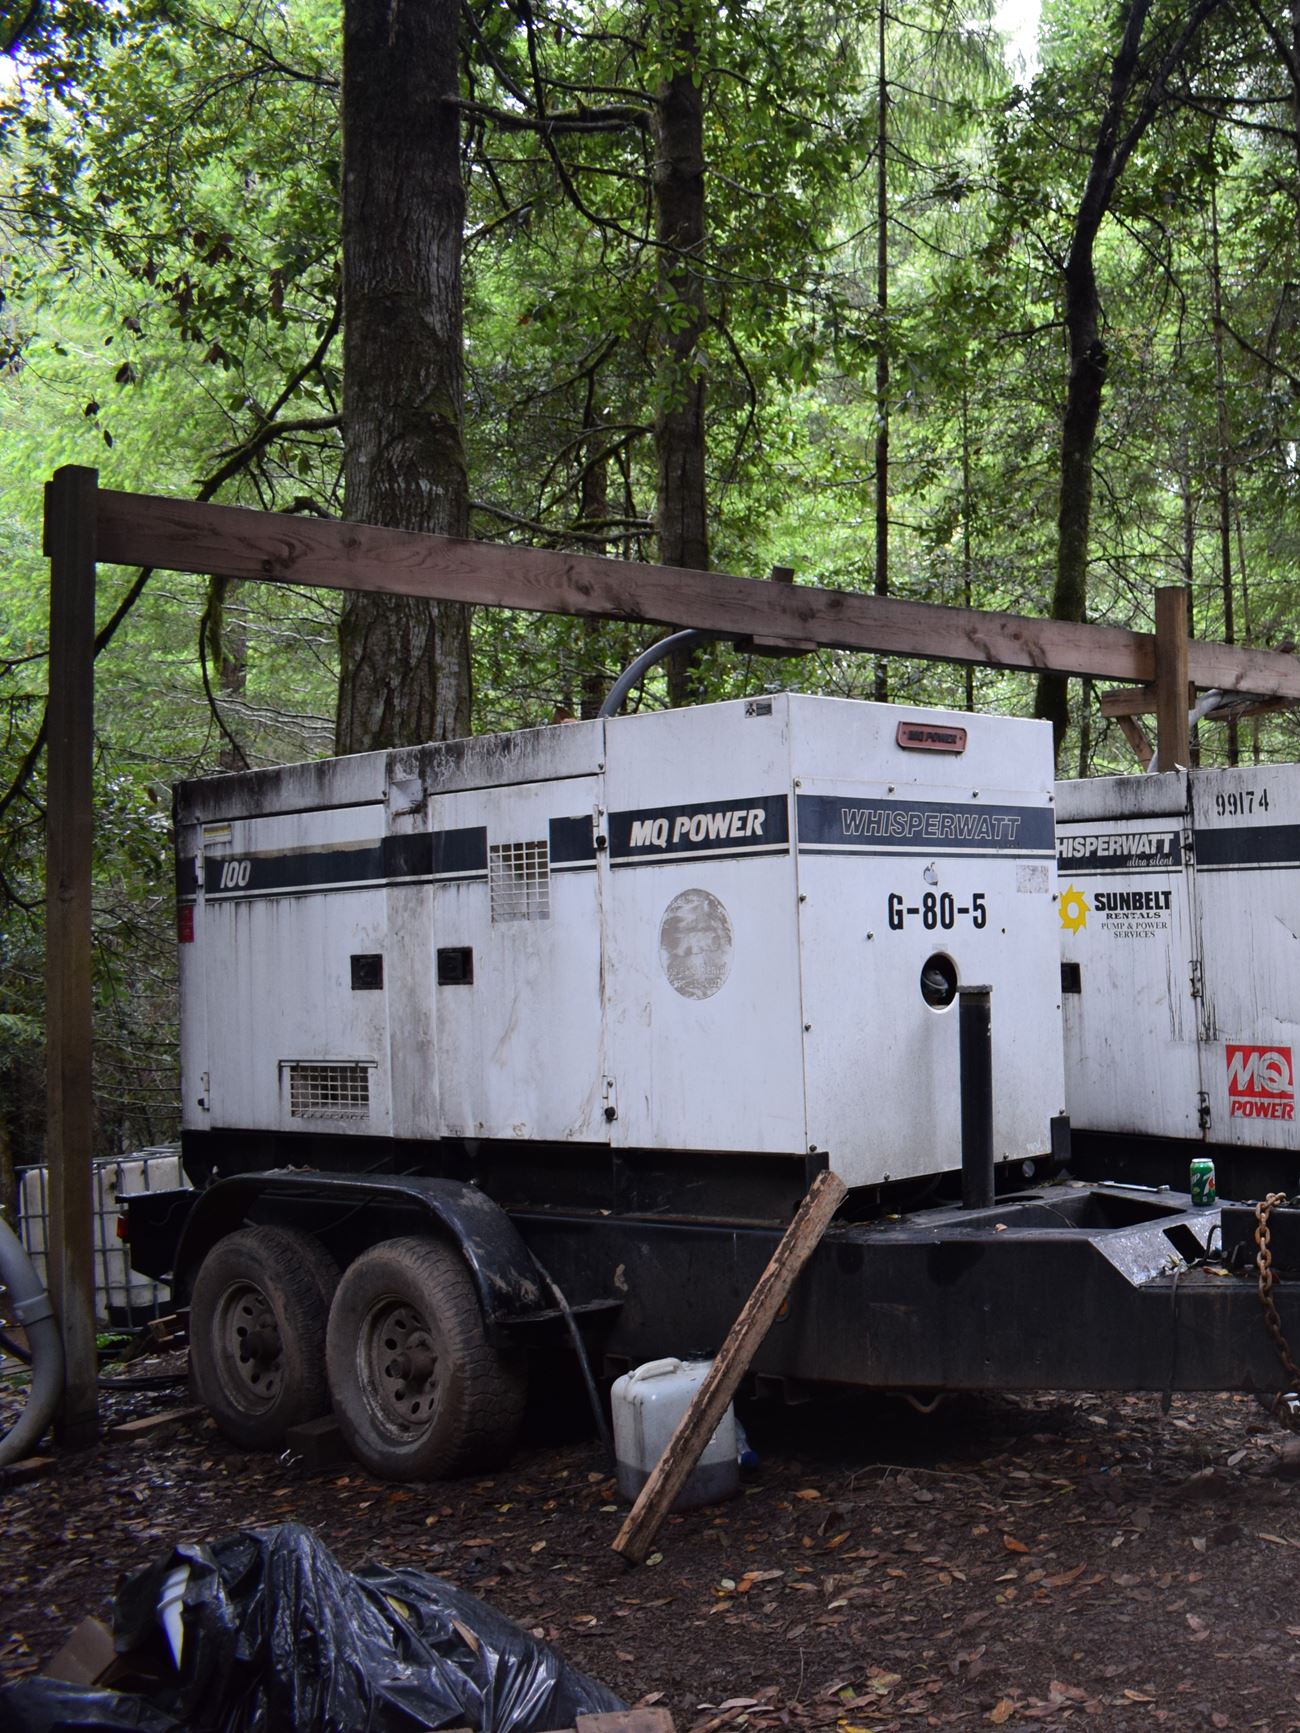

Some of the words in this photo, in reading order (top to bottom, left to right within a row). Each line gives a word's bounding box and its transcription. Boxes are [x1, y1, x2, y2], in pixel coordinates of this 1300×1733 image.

[1216, 788, 1270, 817] 99174
[629, 818, 669, 848] MQ
[672, 808, 766, 843] POWER
[841, 808, 1021, 840] WHISPERWATT
[1056, 832, 1175, 858] HISPERWATT
[1126, 854, 1147, 867] ultra
[1149, 853, 1174, 866] silent
[220, 860, 251, 889] 100
[888, 892, 987, 930] G-80-5
[1094, 891, 1172, 911] SUNBELT
[1101, 922, 1126, 930] PUMP
[1106, 912, 1161, 920] RENTALS
[1113, 931, 1156, 939] SERVICES
[1226, 1051, 1294, 1093] MQ
[1231, 1100, 1295, 1120] POWER
